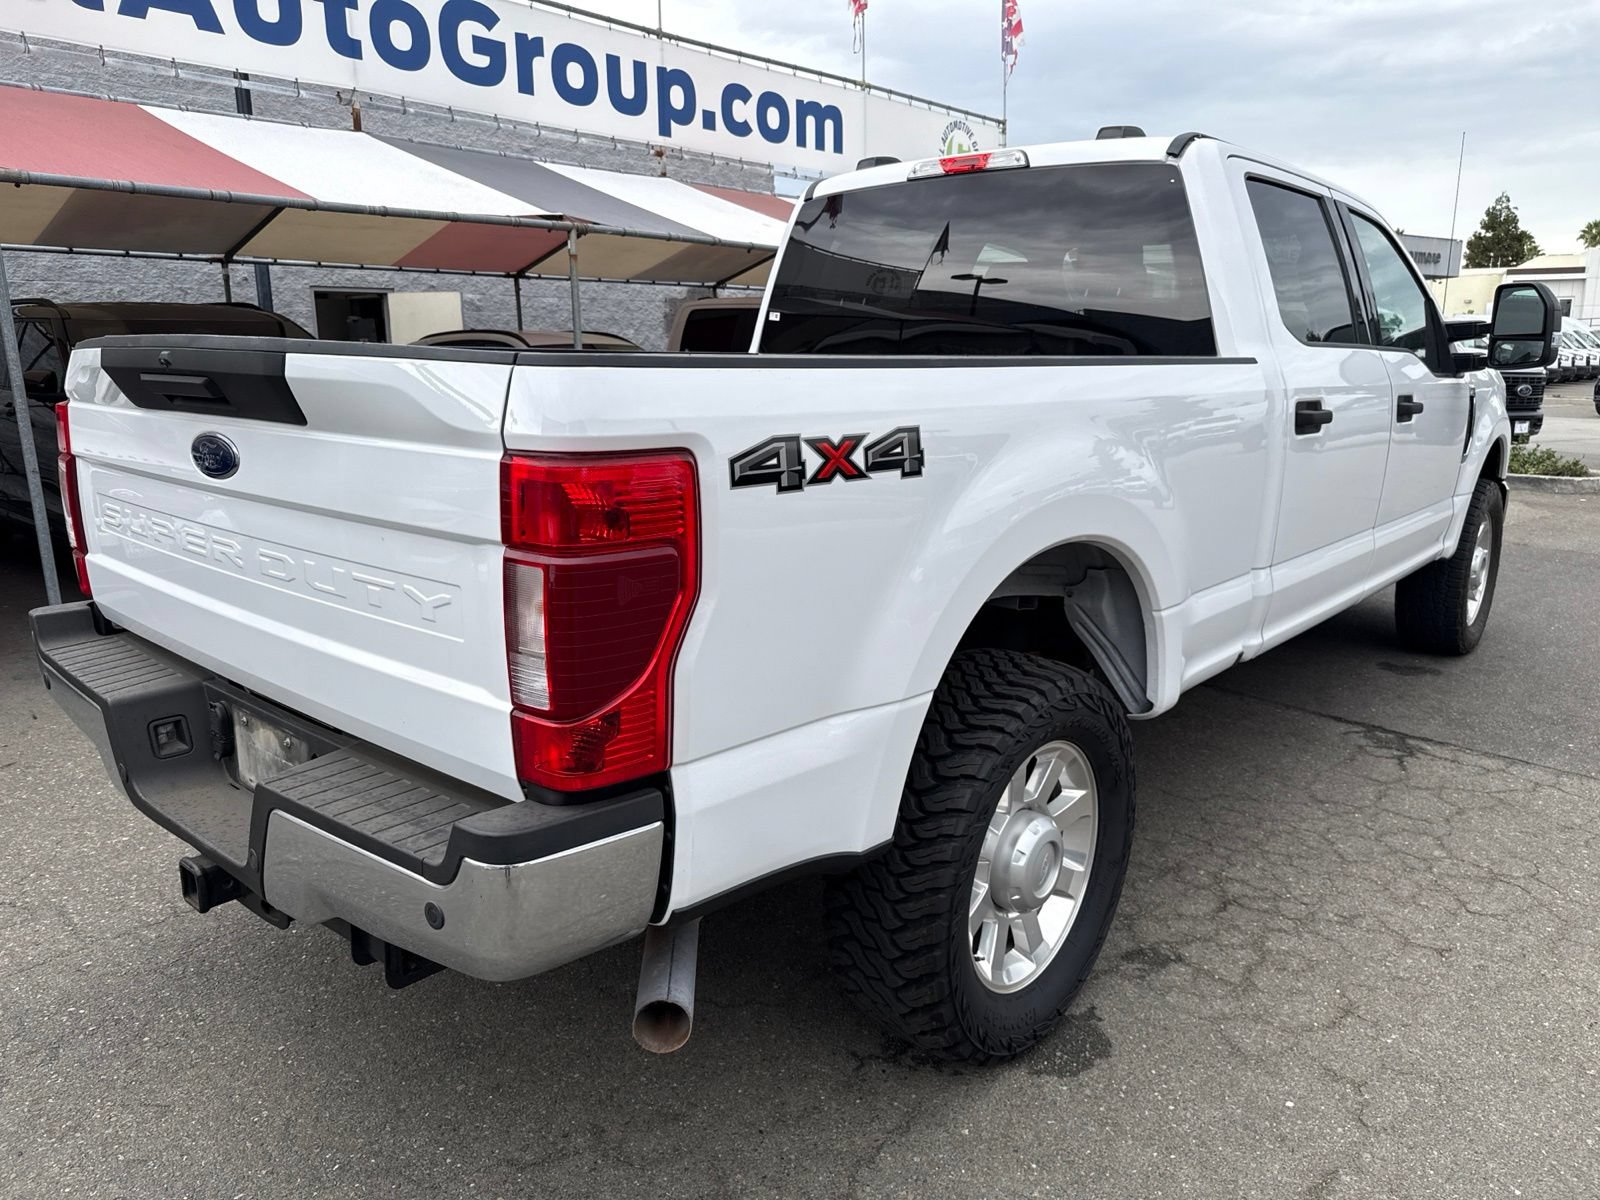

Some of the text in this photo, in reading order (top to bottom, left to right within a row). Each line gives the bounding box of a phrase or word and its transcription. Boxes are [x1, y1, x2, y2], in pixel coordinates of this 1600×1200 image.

[72, 0, 843, 154] utoGroup.com
[941, 120, 975, 146] AUTOMOTIVE
[101, 502, 452, 623] SUPER DUTY
